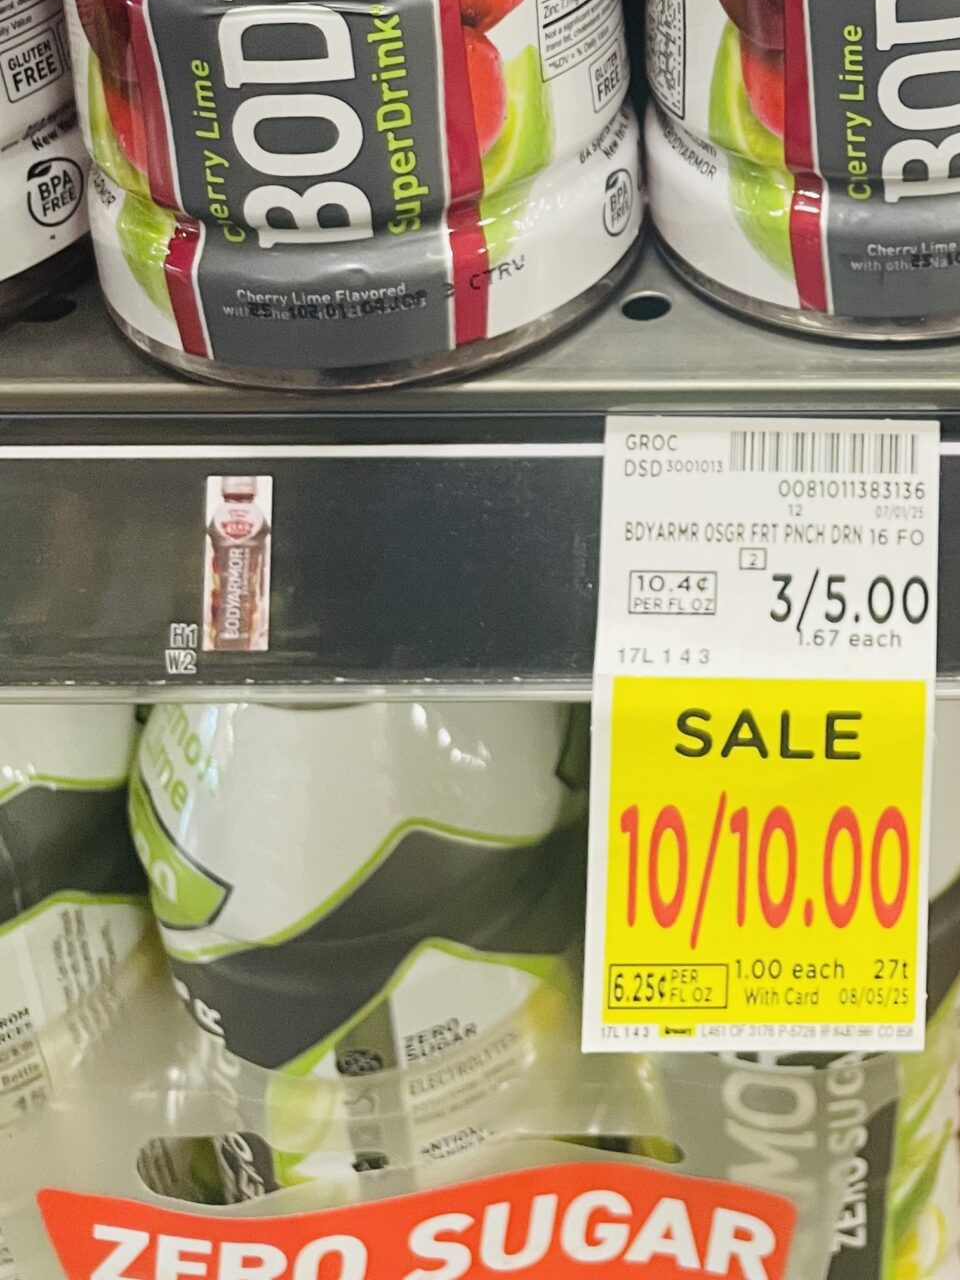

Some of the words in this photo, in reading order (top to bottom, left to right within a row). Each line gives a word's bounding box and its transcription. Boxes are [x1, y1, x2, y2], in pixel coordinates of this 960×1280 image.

[543, 1, 561, 19] Zinc
[8, 40, 53, 72] GLUTEN
[595, 51, 618, 83] GLUTEN
[838, 24, 866, 103] Lime
[12, 55, 58, 92] FREE
[596, 64, 621, 102] FREE
[191, 61, 221, 137] Lime
[38, 170, 73, 202] BPA
[610, 180, 629, 212] BPA
[42, 186, 78, 216] FREE
[610, 199, 631, 227] FREE
[921, 240, 957, 255] Lime
[236, 287, 289, 306] Cherry
[292, 290, 331, 306] Lime
[335, 281, 408, 304] Flavored
[626, 434, 679, 452] GROC
[624, 459, 663, 478] DSD
[666, 459, 724, 474] 3001013
[778, 479, 925, 500] 0081011383136
[788, 504, 803, 518] 12
[624, 521, 700, 543] BDYARMR
[751, 522, 778, 544] FRT
[784, 523, 826, 545] PNCH
[831, 524, 863, 546] DRN
[869, 528, 888, 546] 16
[896, 528, 925, 546] FO
[749, 553, 759, 567] 2
[633, 596, 663, 612] PER
[668, 597, 686, 612] FL
[691, 598, 714, 613] OZ
[770, 568, 930, 633] 3/5.00
[798, 630, 840, 648] 1.67
[849, 630, 903, 648] each
[165, 650, 198, 674] W2
[618, 648, 654, 665] 17L
[674, 707, 862, 760] SALE
[620, 789, 910, 950] 10/10.00
[671, 968, 699, 984] PER
[735, 959, 783, 980] 1.00
[792, 958, 845, 980] each
[873, 959, 909, 980] 27t
[670, 987, 687, 1002] FL
[692, 987, 713, 1002] OZ
[744, 986, 780, 1006] With
[784, 986, 820, 1006] Card
[838, 986, 910, 1008] 08/05/25
[601, 1026, 620, 1039] 17L
[89, 1223, 369, 1280] ZERO
[403, 1187, 777, 1280] SUGAR
